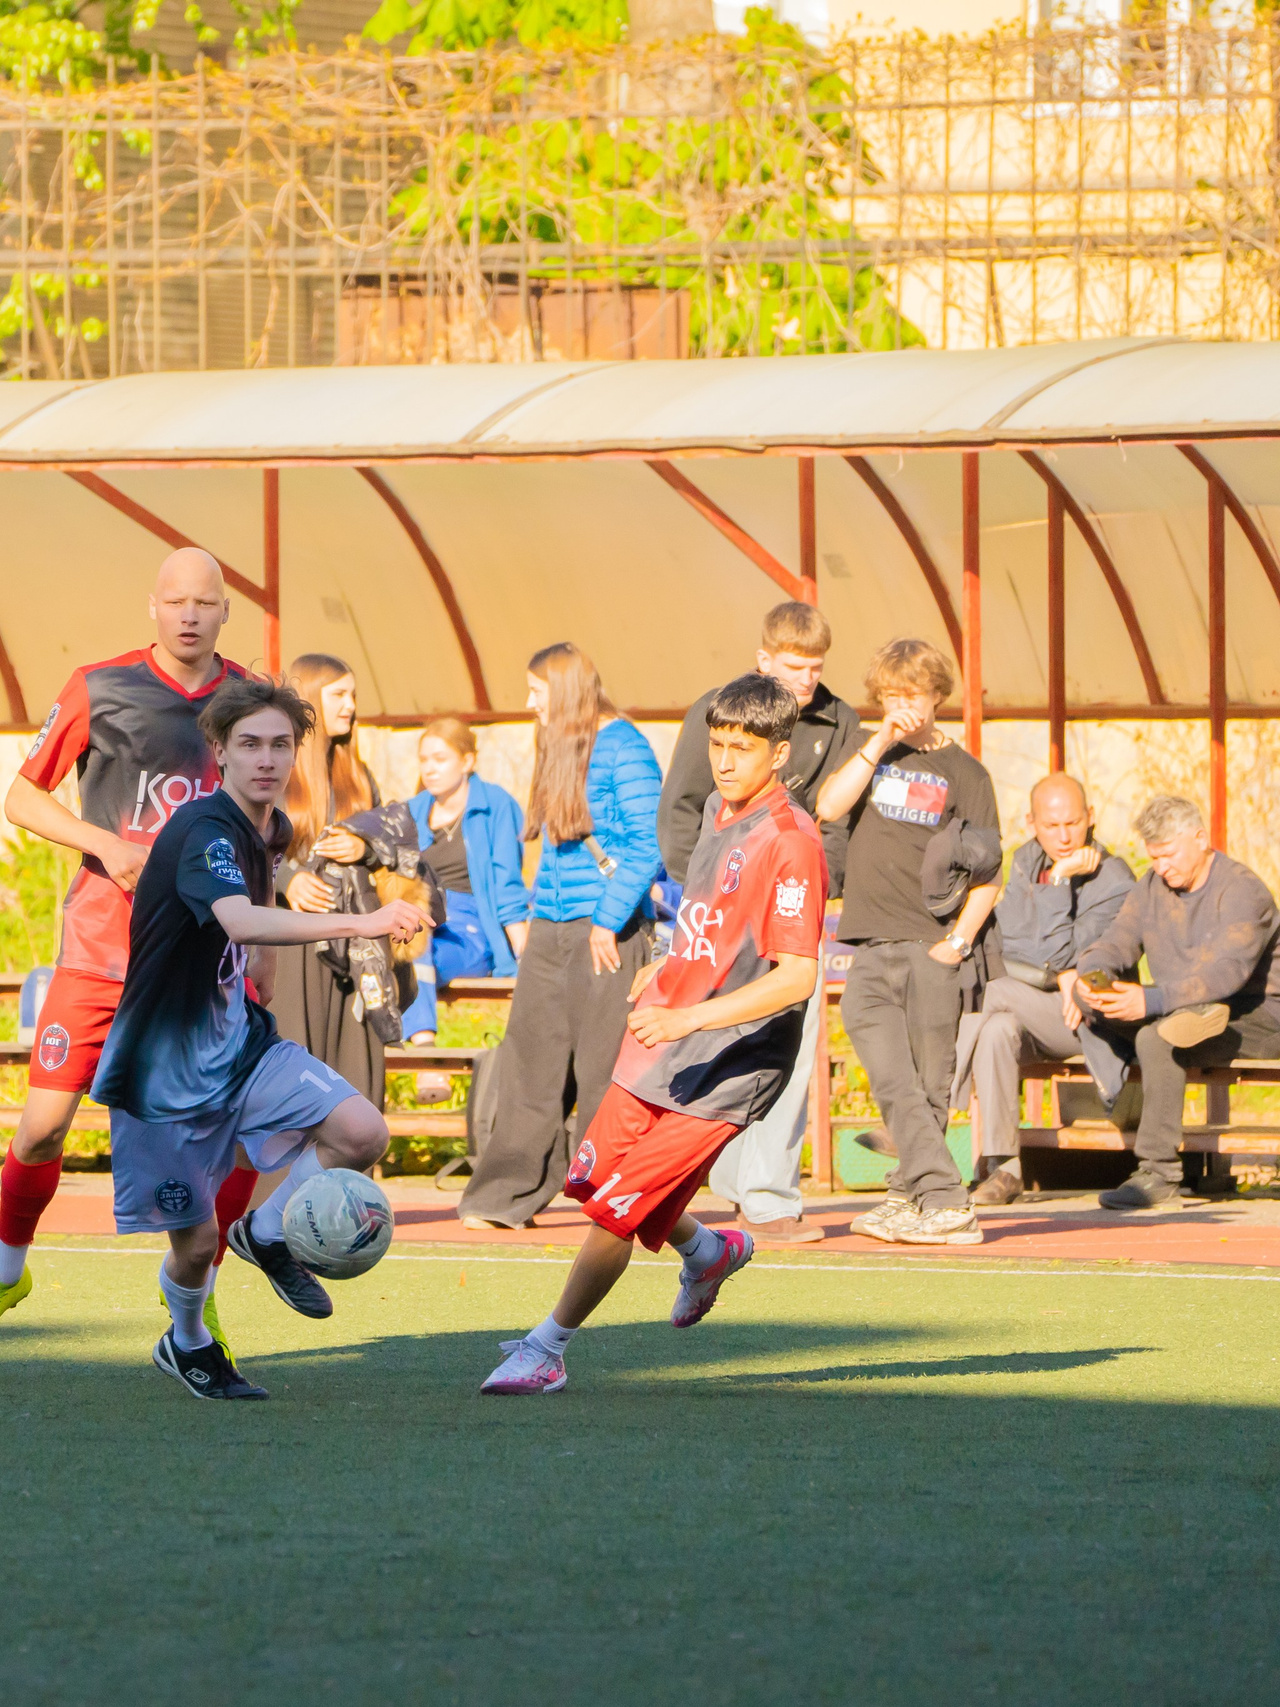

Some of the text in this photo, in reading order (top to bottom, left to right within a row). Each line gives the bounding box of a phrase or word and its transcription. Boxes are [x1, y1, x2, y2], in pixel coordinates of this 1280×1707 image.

[881, 765, 943, 787] TOMMY
[45, 1037, 62, 1046] ЮГ
[592, 1172, 643, 1220] 14
[304, 1200, 327, 1248] DEMIX
